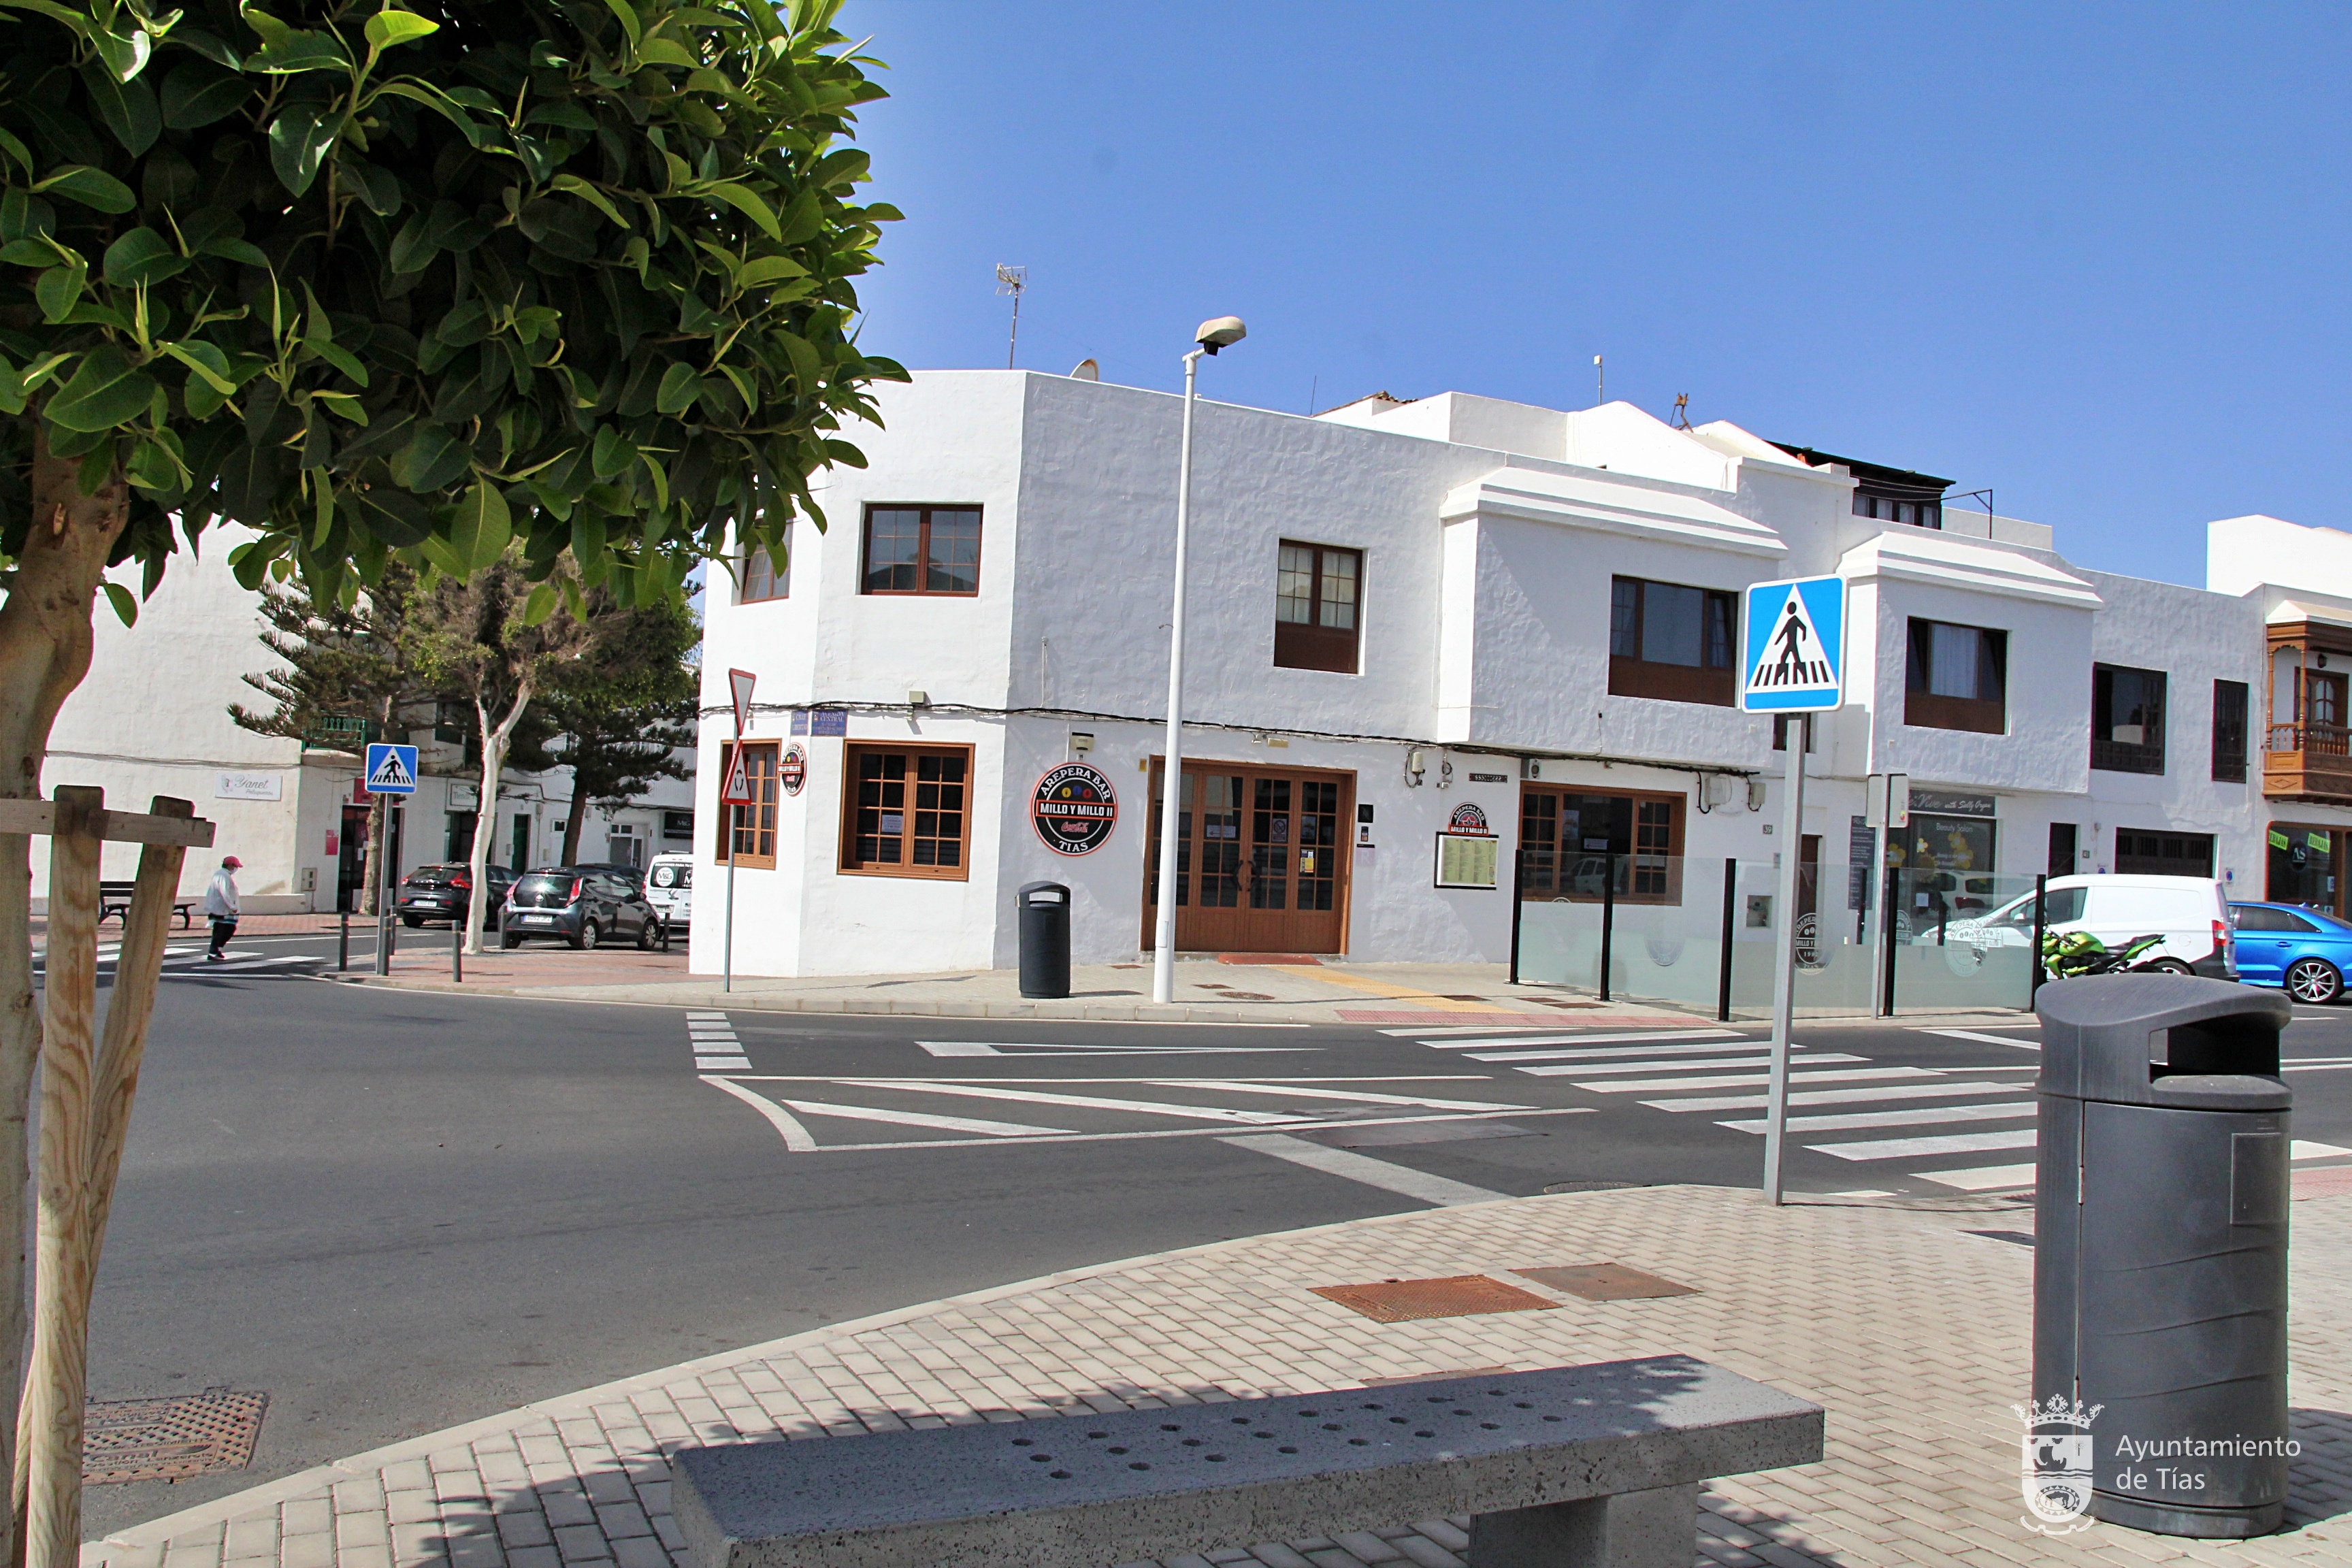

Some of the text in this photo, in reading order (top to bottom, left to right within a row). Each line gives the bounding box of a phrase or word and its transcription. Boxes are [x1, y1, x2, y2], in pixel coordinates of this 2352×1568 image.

[235, 774, 269, 789] Yanet
[1040, 767, 1111, 800] AREPERA BAR
[1040, 802, 1113, 817] MILLO Y MILLO II
[1454, 805, 1476, 819] AREPERA
[1476, 809, 1485, 821] BAR
[1765, 826, 1771, 834] 39
[1936, 822, 1973, 832] Beauty Salon
[1058, 840, 1089, 852] TIAS
